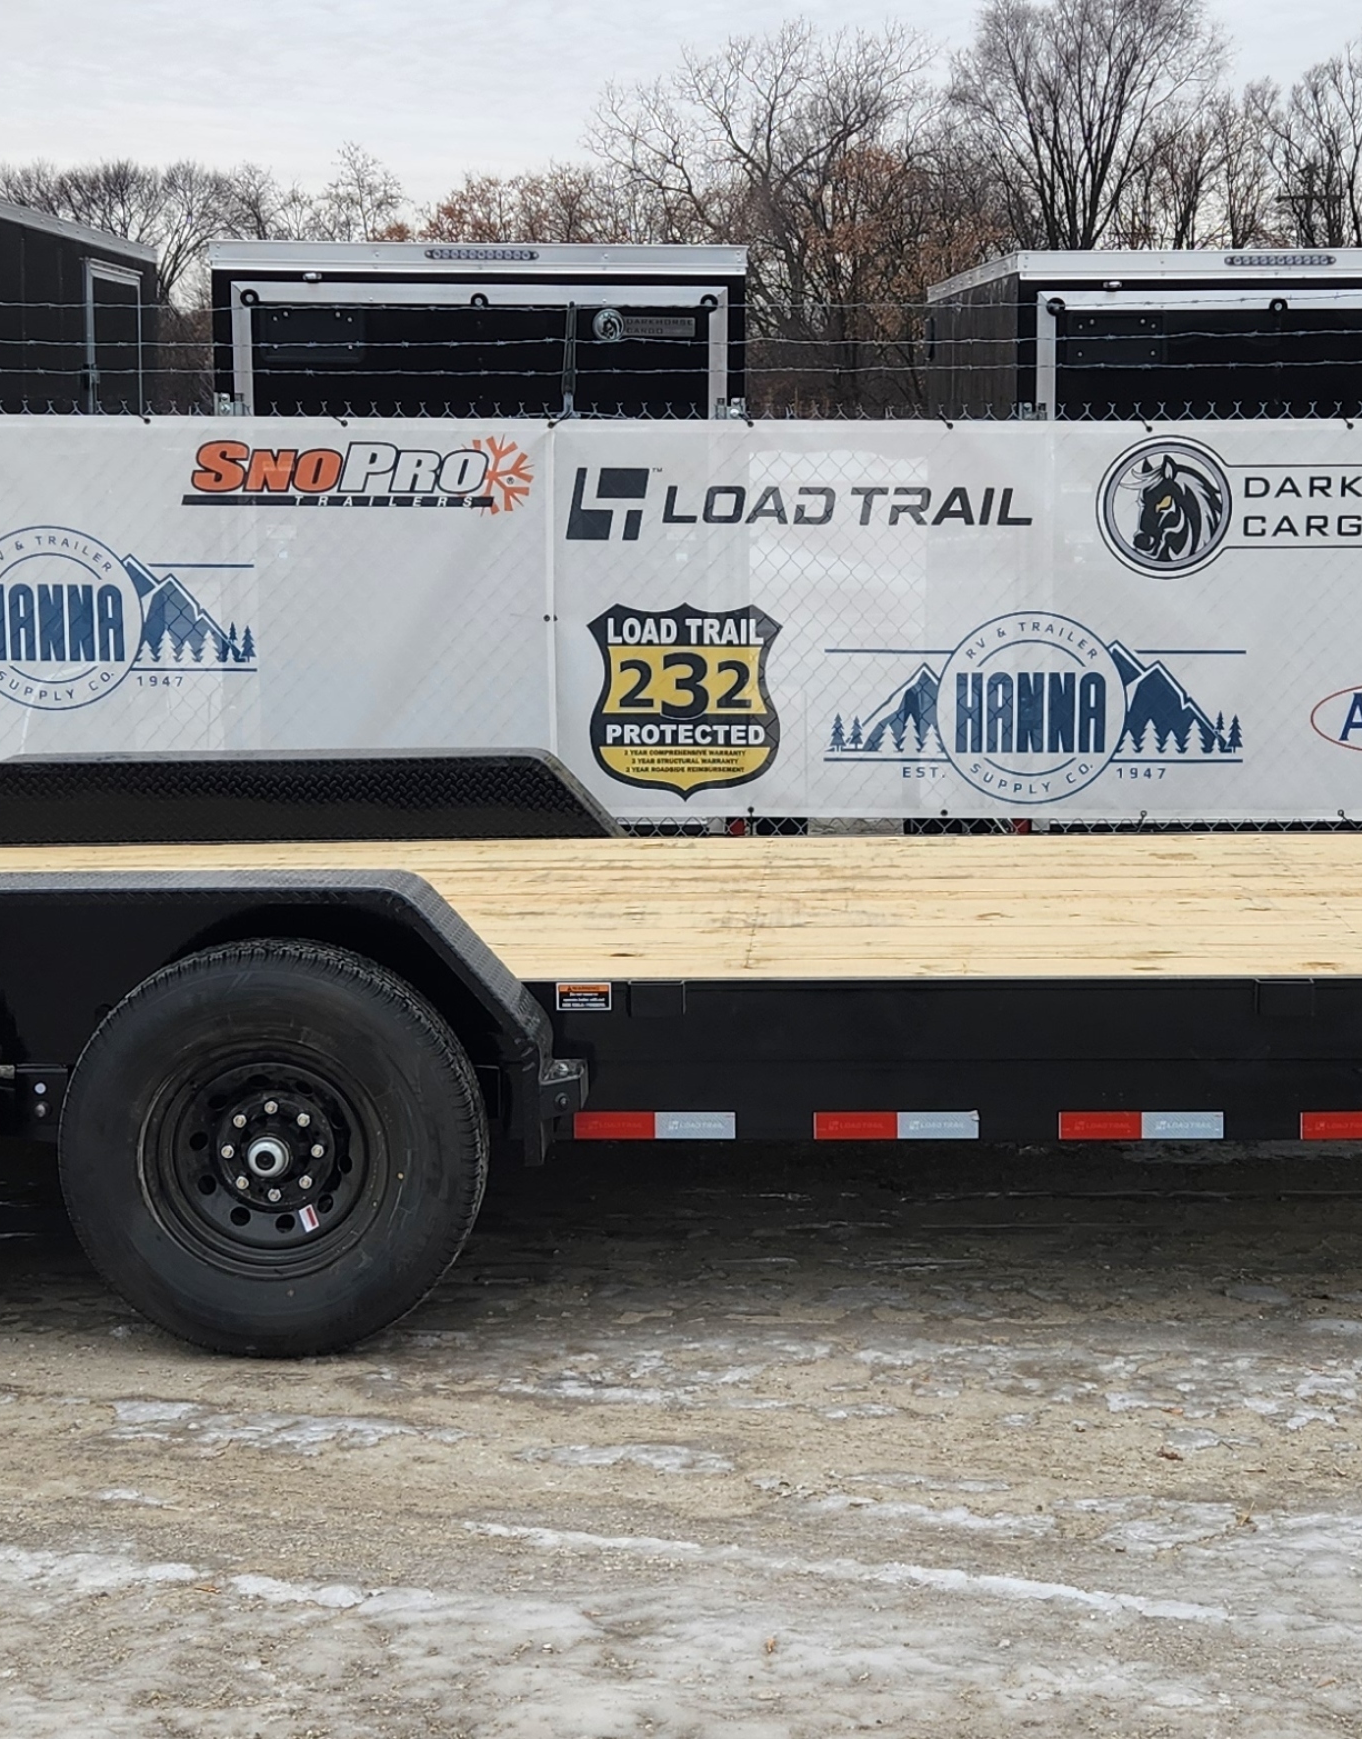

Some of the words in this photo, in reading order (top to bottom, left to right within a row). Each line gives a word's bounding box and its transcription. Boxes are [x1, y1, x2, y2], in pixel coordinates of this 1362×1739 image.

[294, 495, 474, 508] TRAILERS
[662, 486, 836, 525] LOAD
[850, 486, 1033, 526] TRAIL
[15, 540, 25, 551] &
[35, 536, 112, 572] TRAILER
[607, 617, 677, 645] LOAD
[685, 618, 764, 645] TRAIL
[965, 638, 986, 660] RV
[997, 627, 1006, 638] &
[1018, 622, 1098, 660] TRAILER
[88, 671, 115, 692] CO.
[136, 676, 183, 688] 1947
[618, 652, 752, 720] 232
[955, 672, 1106, 753] HANNA
[605, 723, 766, 746] PROTECTED
[902, 767, 945, 779] EST.
[1116, 768, 1166, 780] 1947
[970, 763, 1050, 794] SUPPLY
[1065, 763, 1093, 784] CO.
